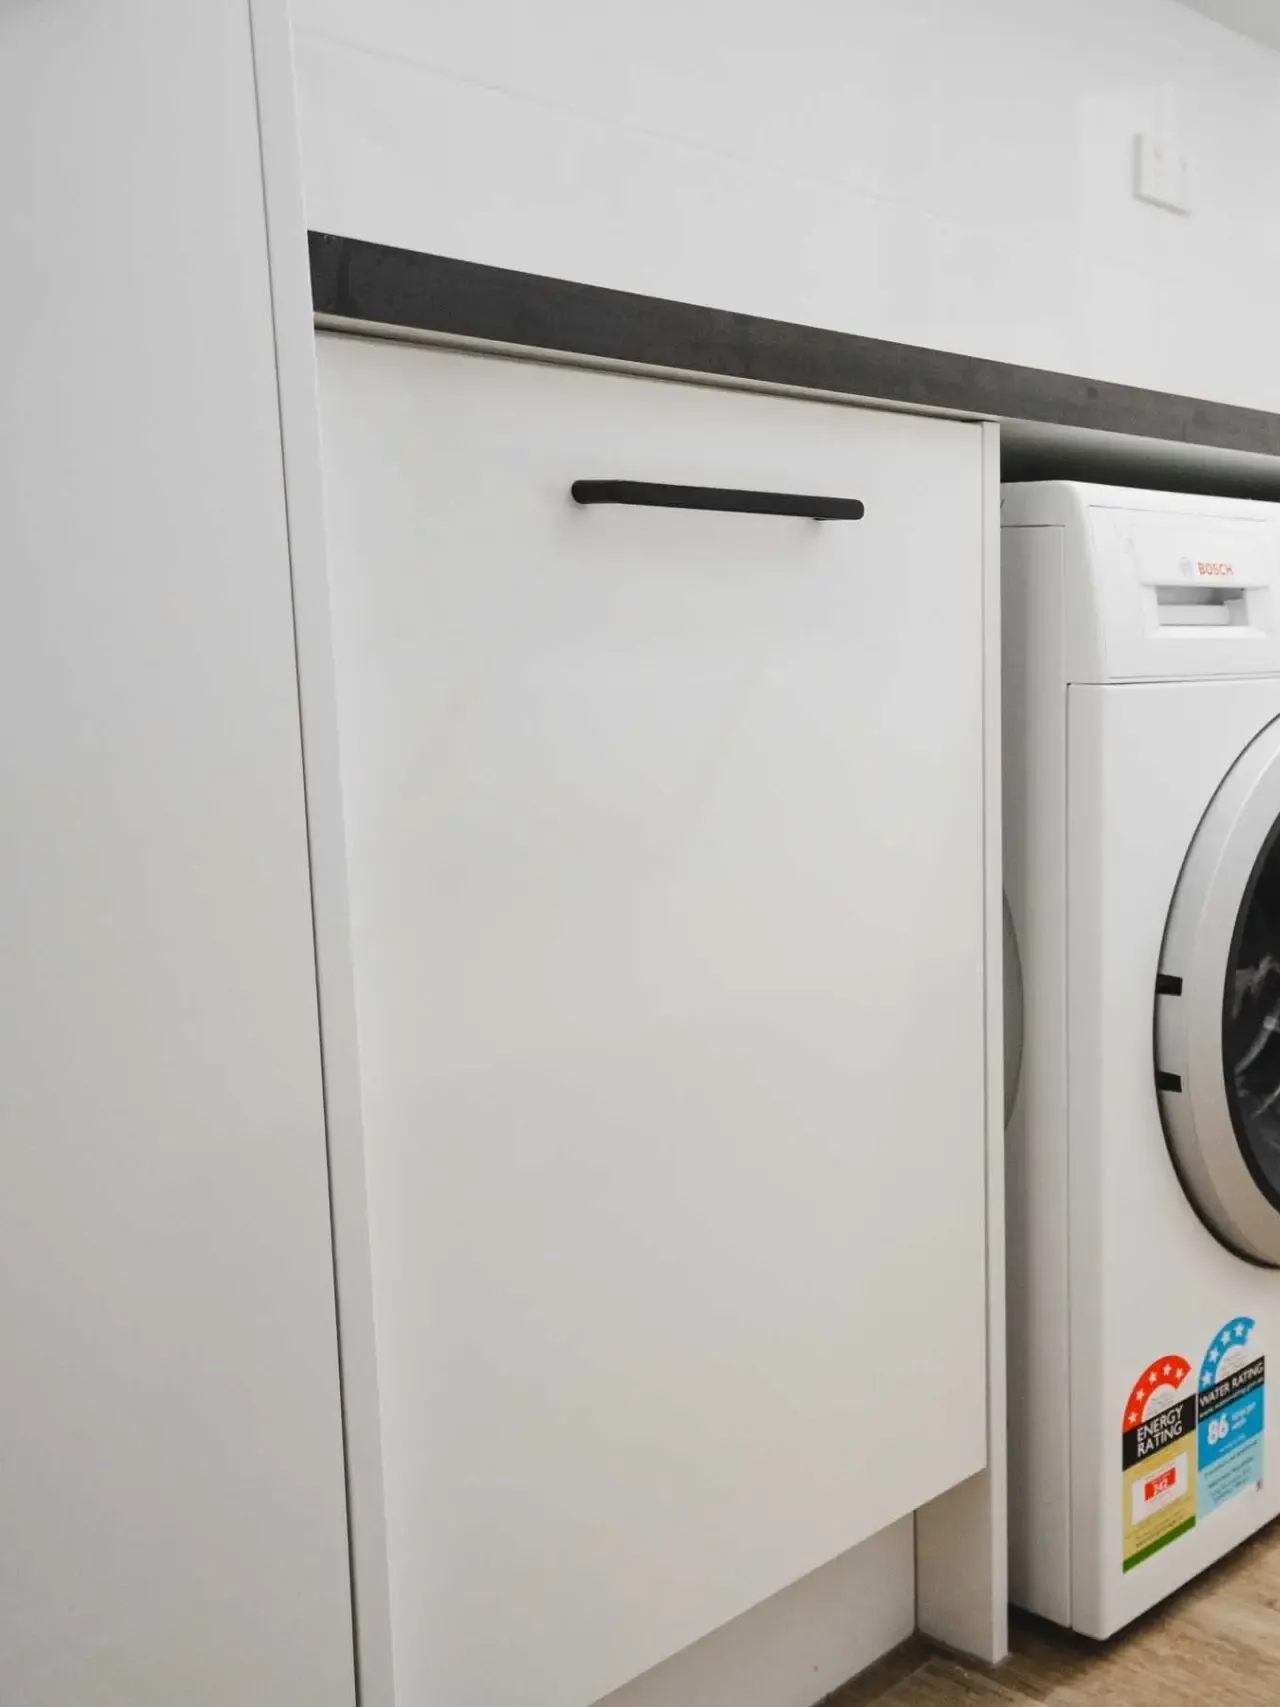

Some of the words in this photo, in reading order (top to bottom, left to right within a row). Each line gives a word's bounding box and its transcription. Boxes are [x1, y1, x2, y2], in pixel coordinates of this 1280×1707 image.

[1197, 561, 1234, 576] BOSCH
[1200, 1381, 1231, 1408] WATER
[1231, 1361, 1264, 1389] RATING
[1137, 1402, 1184, 1443] ENERGY
[1137, 1420, 1183, 1458] RATING
[1207, 1412, 1229, 1445] 86
